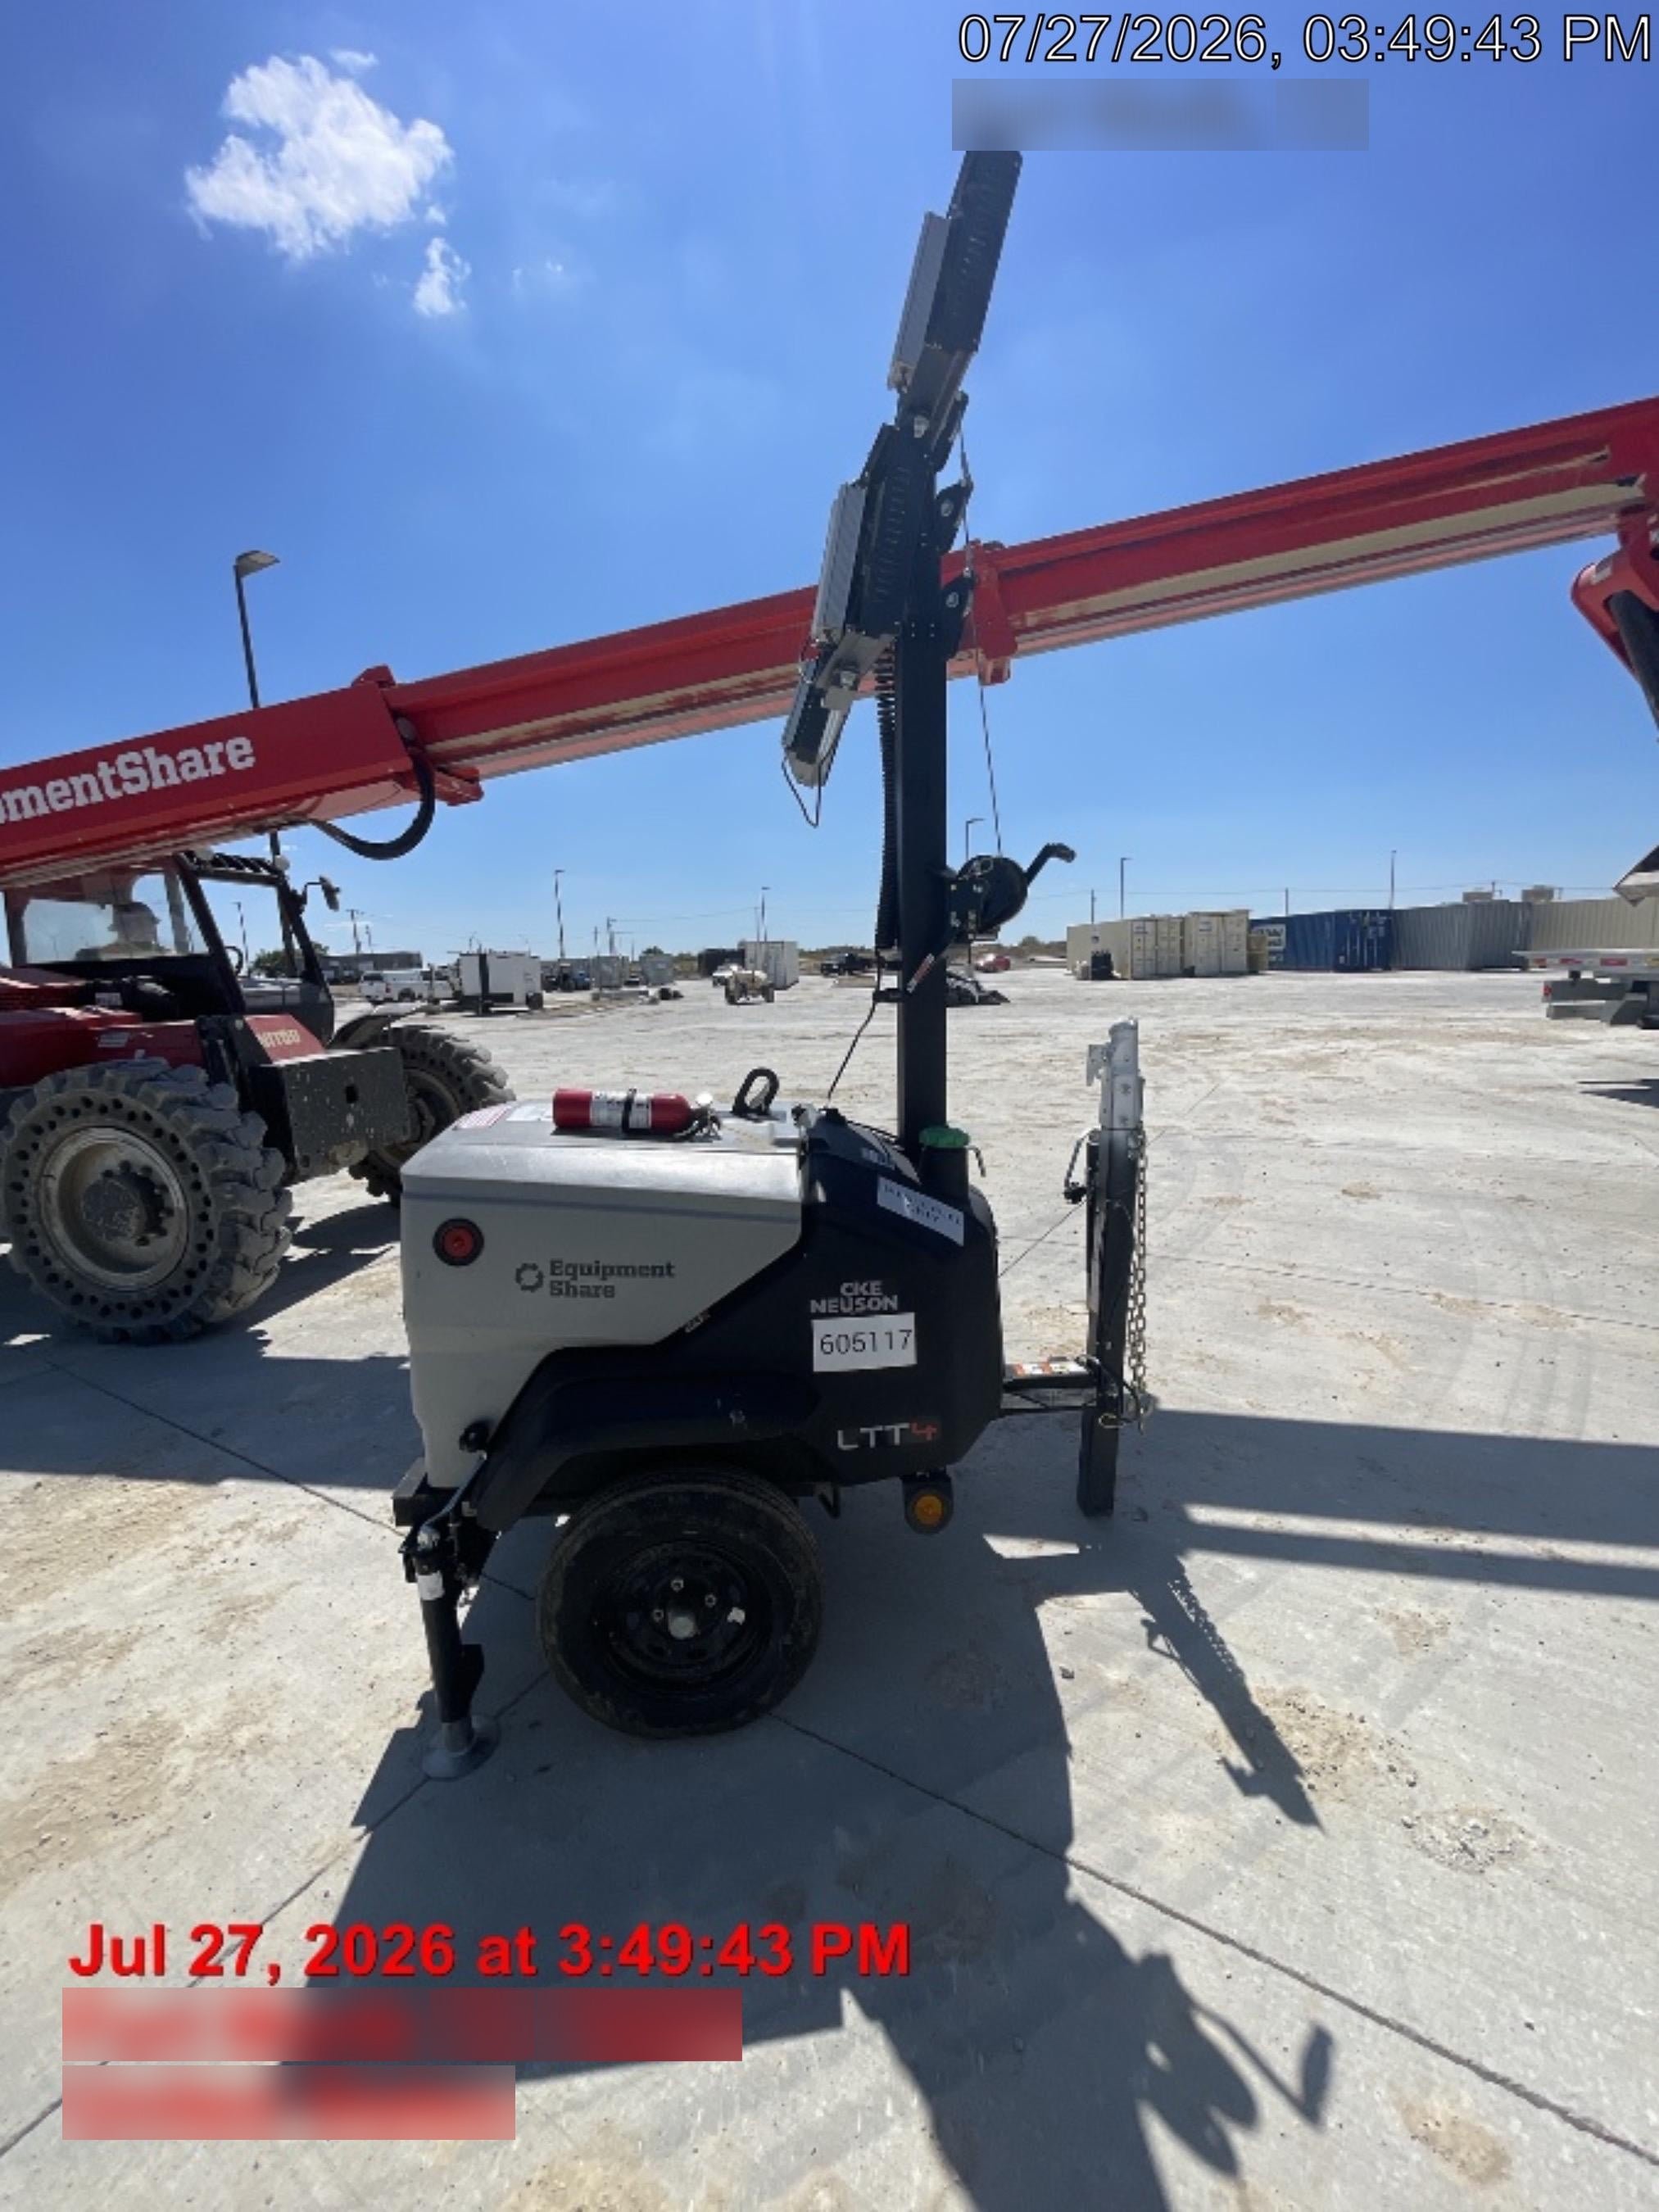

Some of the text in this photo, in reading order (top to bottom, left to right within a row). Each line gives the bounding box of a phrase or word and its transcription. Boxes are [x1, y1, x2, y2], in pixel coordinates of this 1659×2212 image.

[0, 737, 256, 824] mentShare
[550, 1259, 675, 1281] Equipment
[550, 1280, 615, 1298] Share
[810, 1294, 898, 1314] NEUSON
[820, 1329, 913, 1355] 605117
